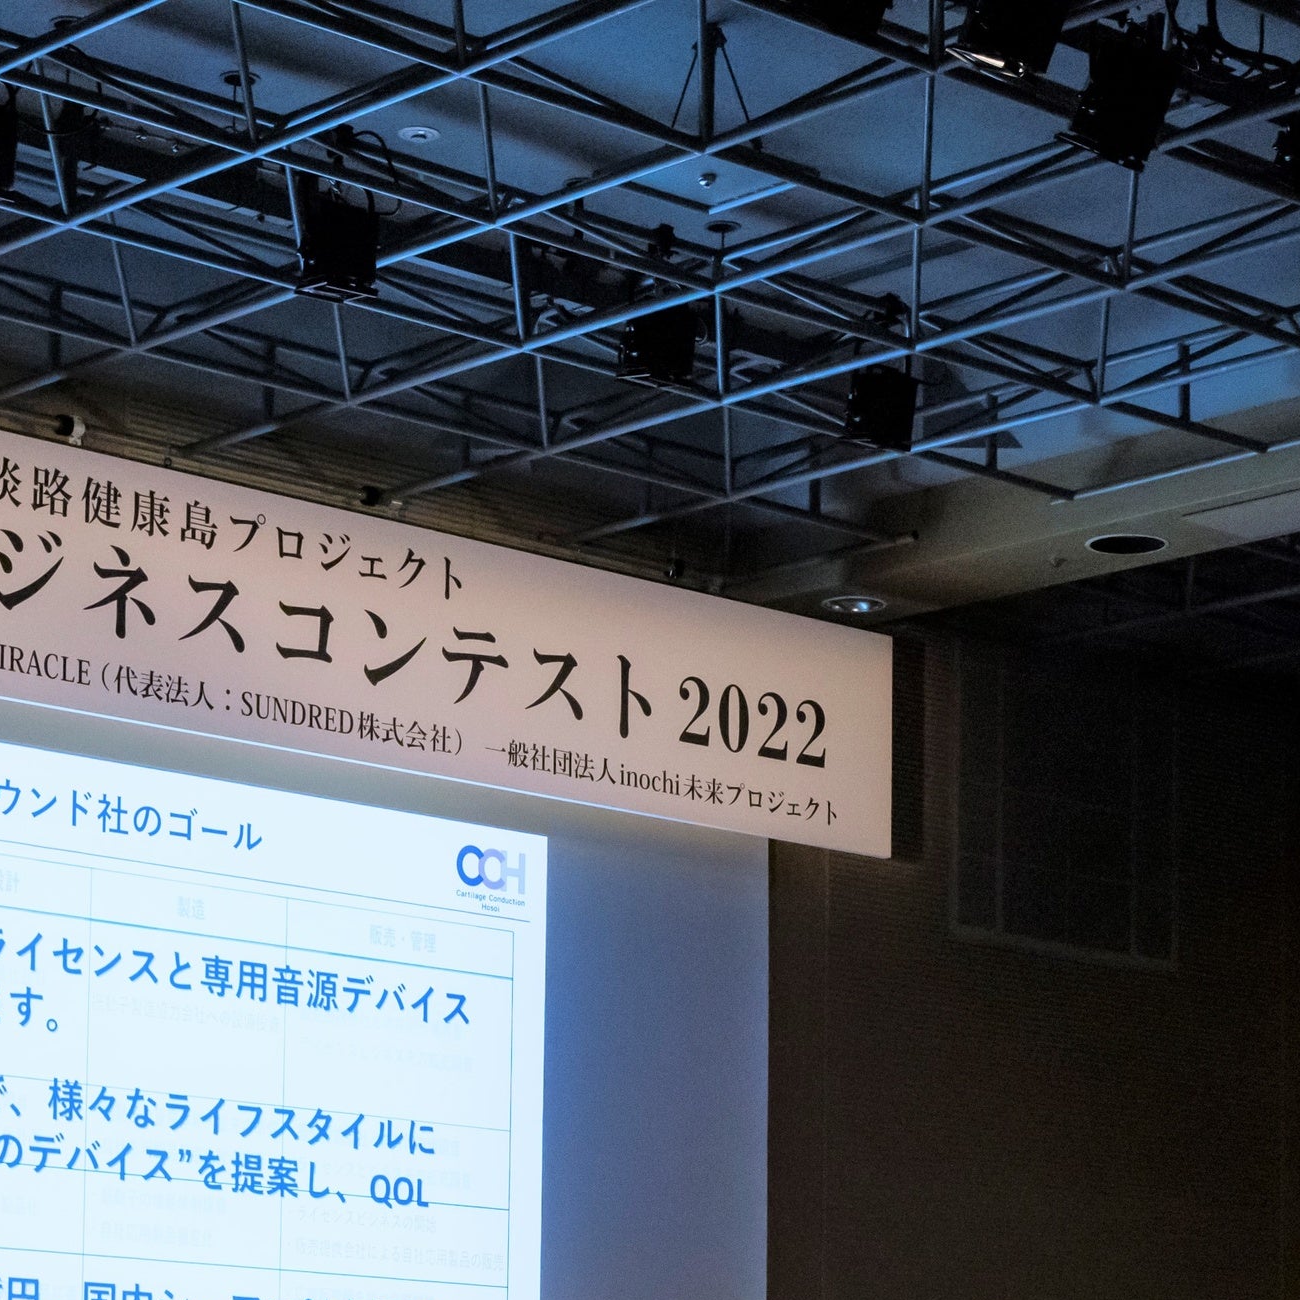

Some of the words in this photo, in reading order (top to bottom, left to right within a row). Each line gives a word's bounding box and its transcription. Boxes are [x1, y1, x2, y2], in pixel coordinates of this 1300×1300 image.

[678, 675, 828, 769] 2022
[457, 845, 526, 894] CCH
[456, 889, 487, 902] Cartilage
